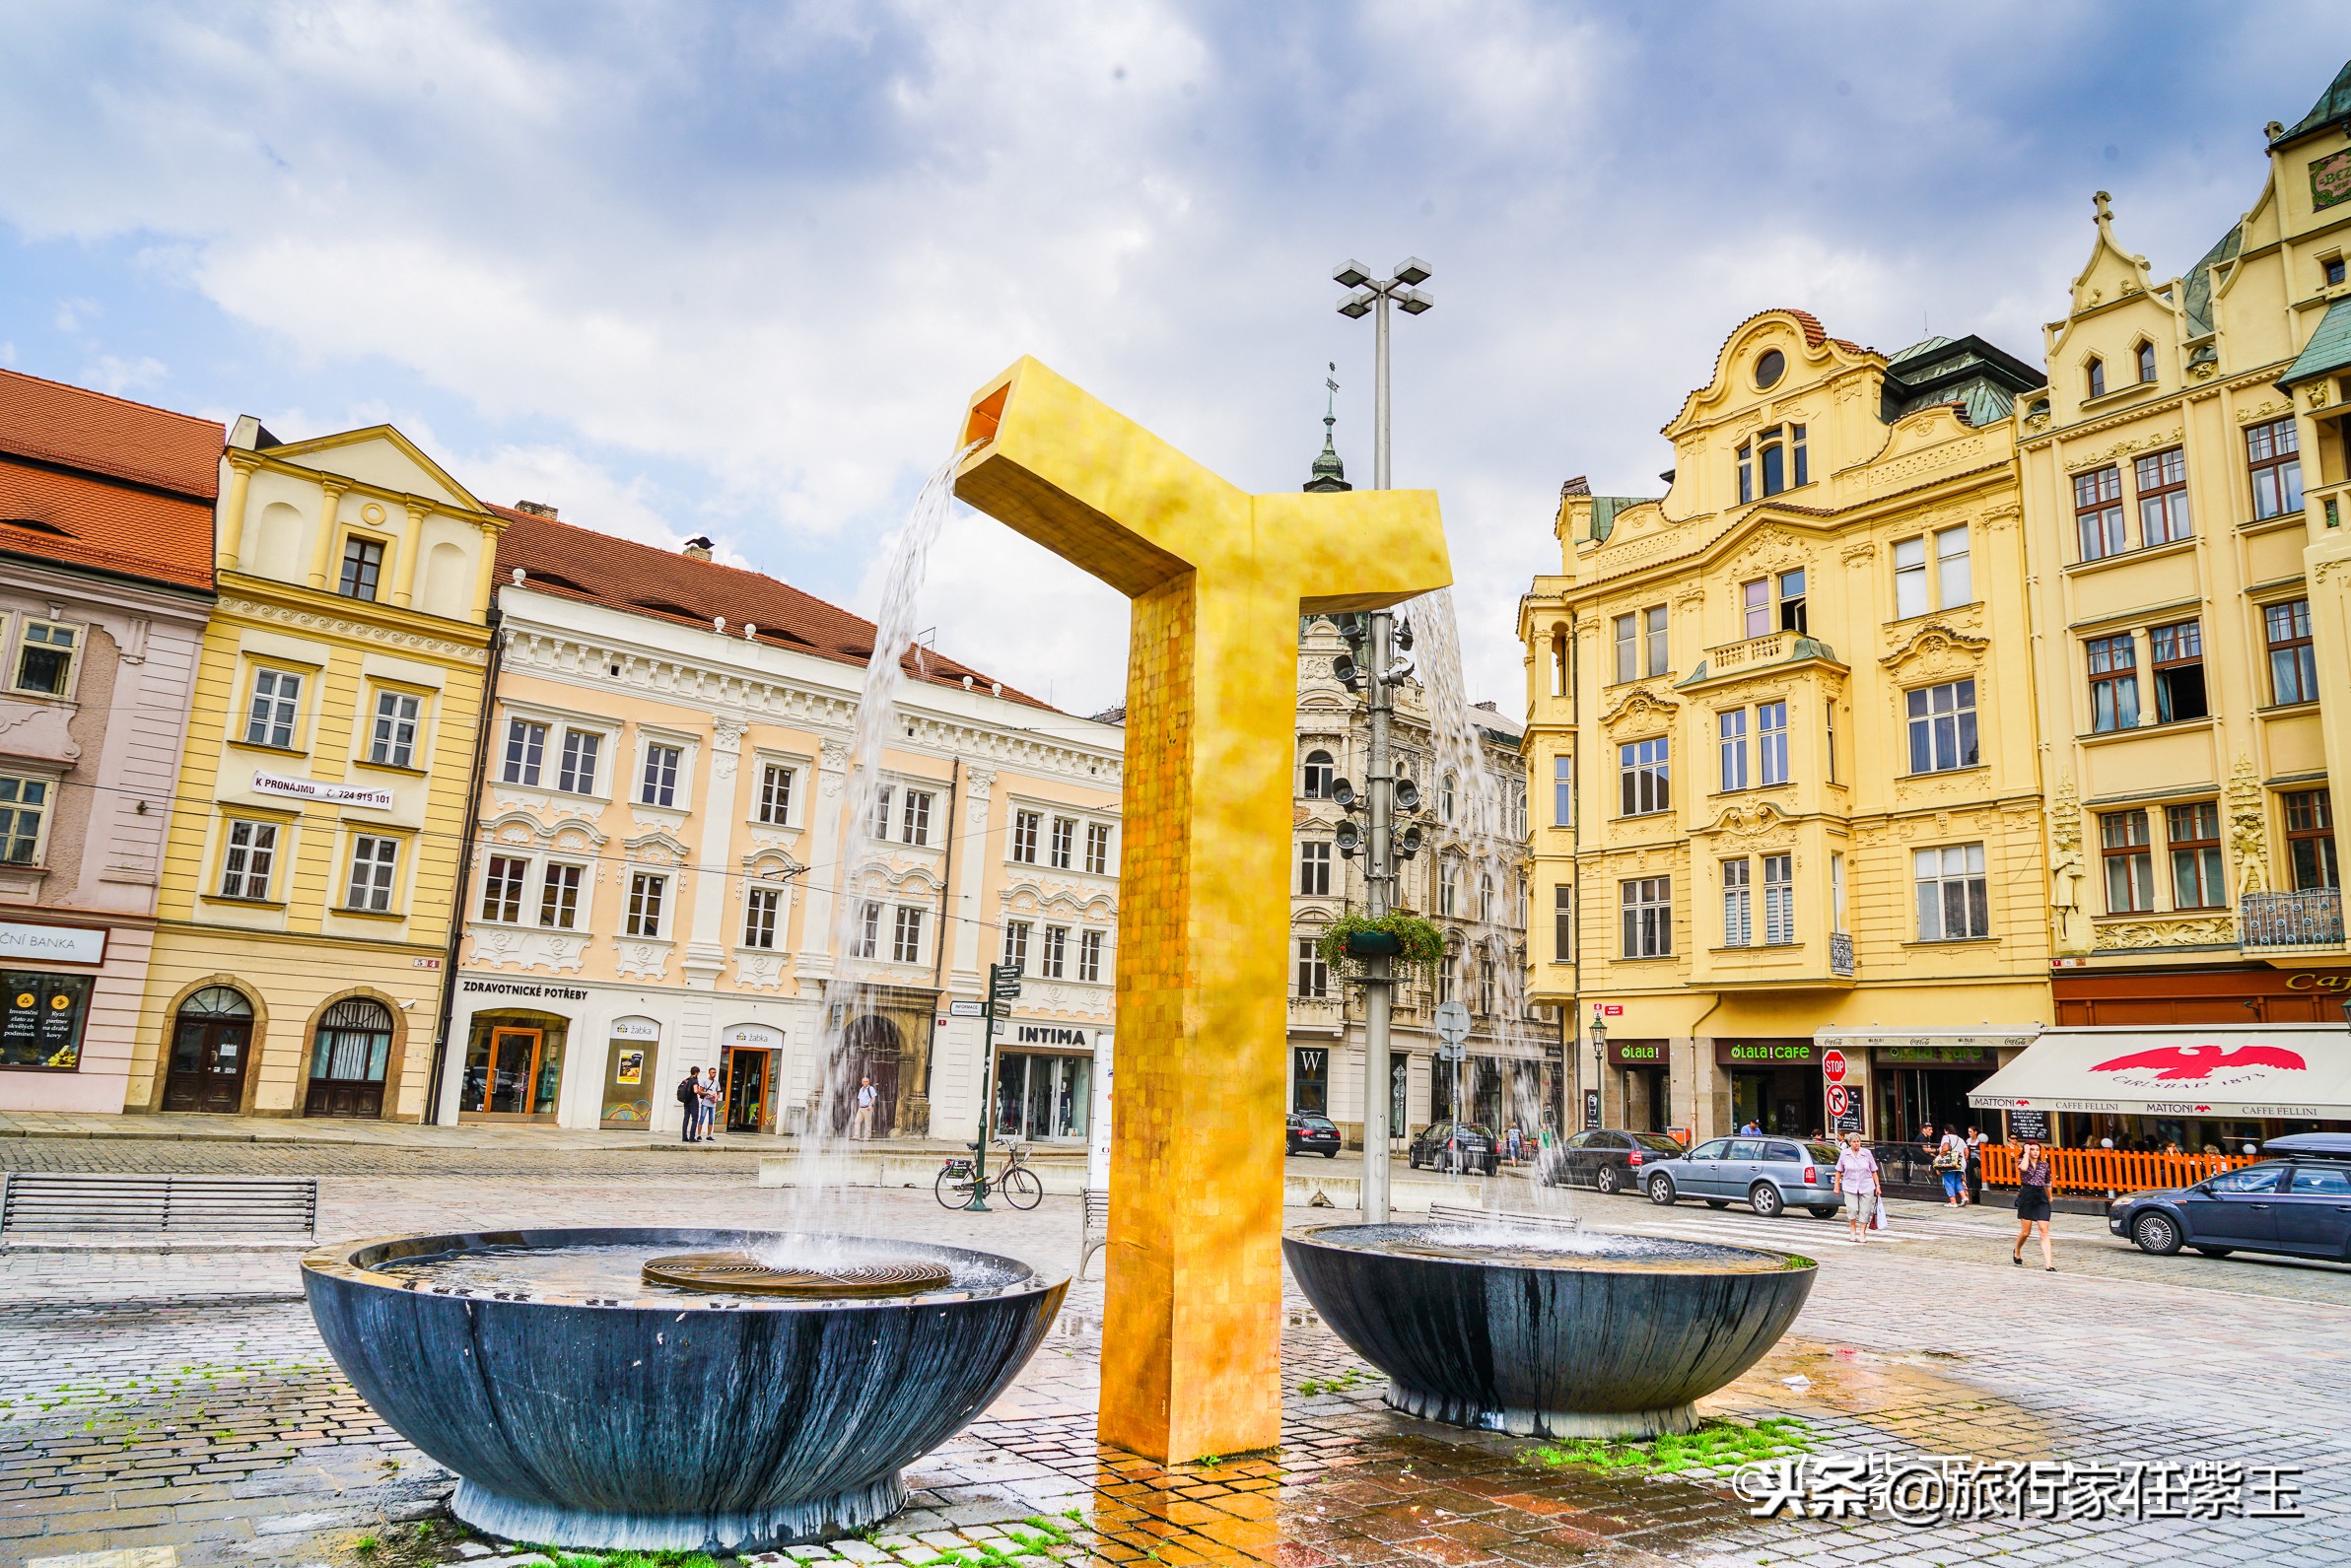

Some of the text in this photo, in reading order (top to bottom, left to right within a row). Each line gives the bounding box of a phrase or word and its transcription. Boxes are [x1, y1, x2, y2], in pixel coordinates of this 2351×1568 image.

[255, 777, 390, 804] K PRONÁJMU 724 919 101
[30, 935, 76, 950] BANKA
[462, 981, 588, 1000] ZDRAVOTNICKÉ POTŘEBY
[631, 1025, 653, 1035] žabka
[1018, 1026, 1086, 1046] INTIMA
[748, 1033, 769, 1043] žabka
[1301, 1051, 1322, 1071] W
[1826, 1060, 1844, 1072] STOP
[2112, 1075, 2209, 1089] CARLSBAD
[1974, 1098, 2015, 1107] MATTONI
[2055, 1101, 2119, 1111] CAFFE FELLINI
[2146, 1103, 2193, 1114] MATTONI
[2242, 1106, 2317, 1117] CAFFE FELLINI
